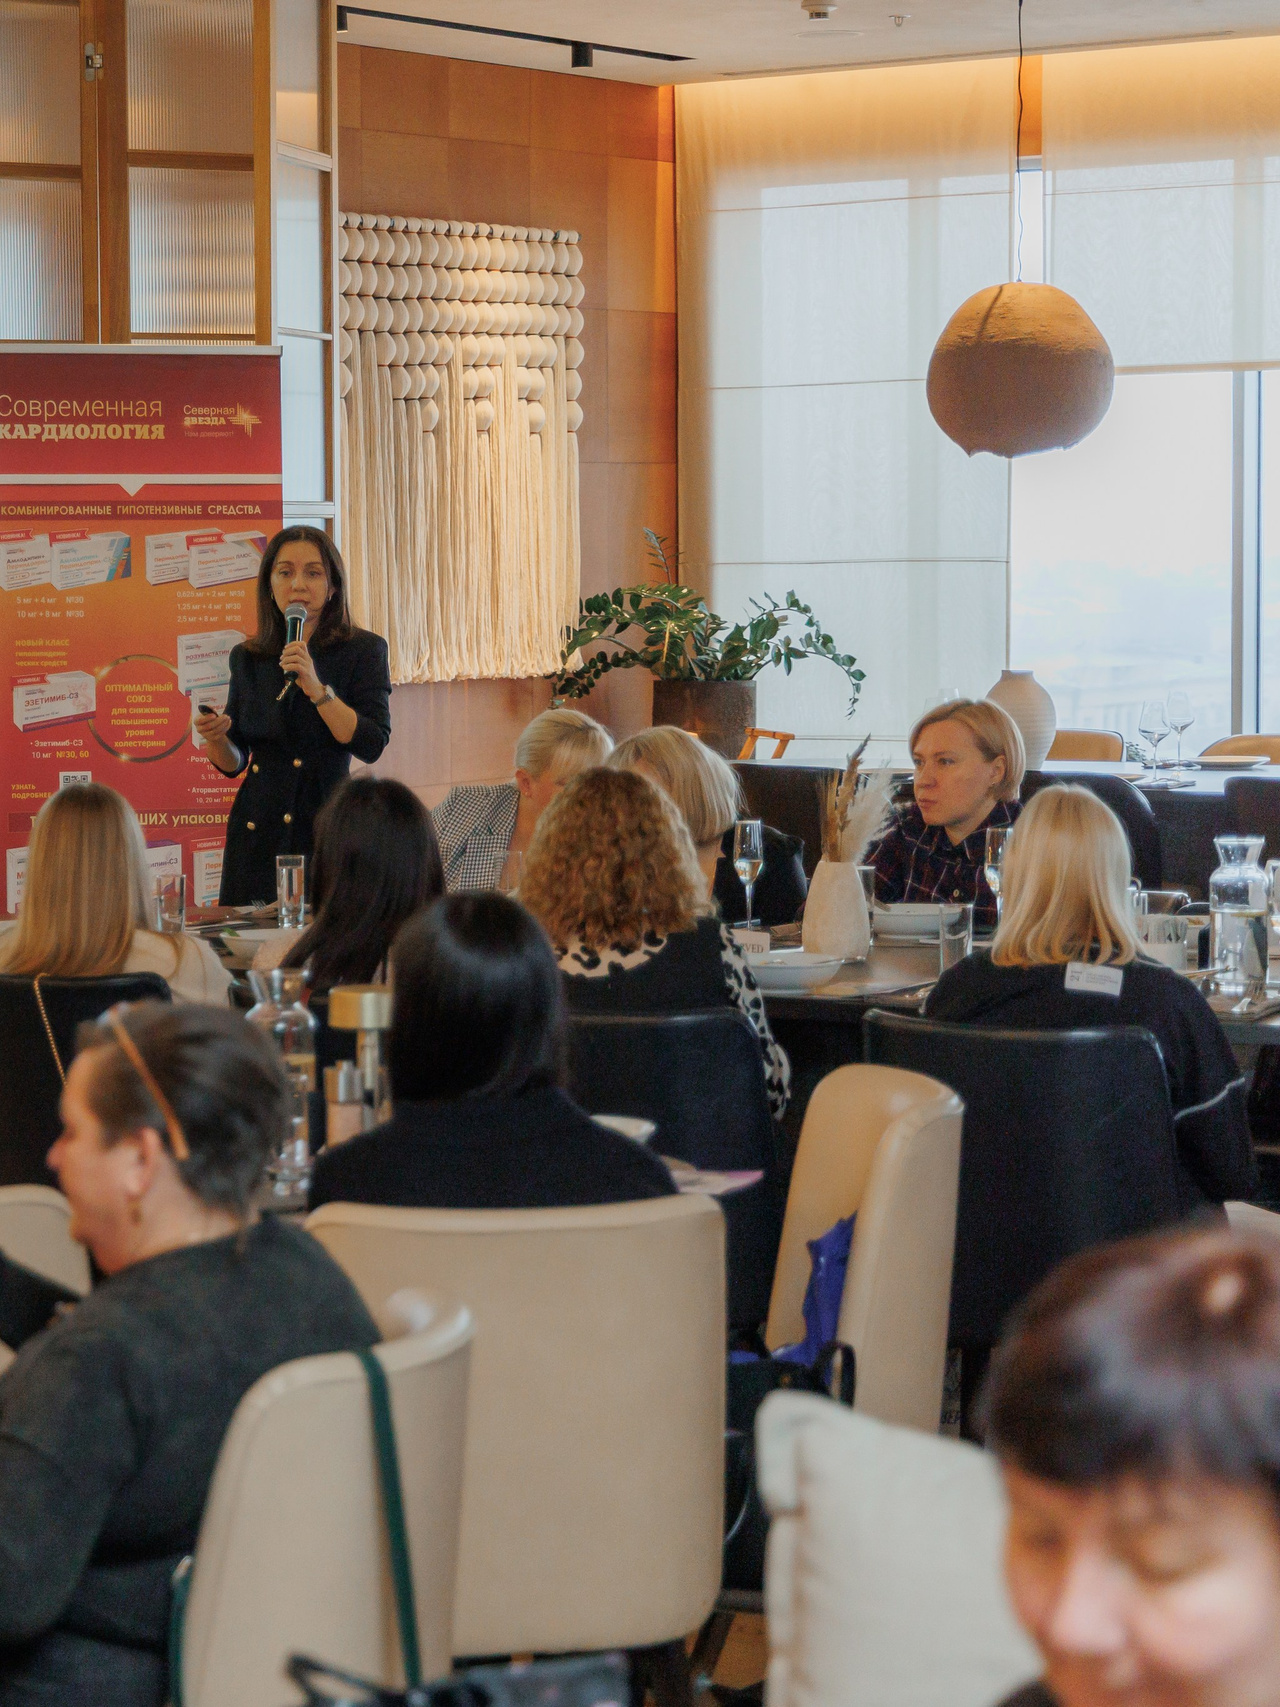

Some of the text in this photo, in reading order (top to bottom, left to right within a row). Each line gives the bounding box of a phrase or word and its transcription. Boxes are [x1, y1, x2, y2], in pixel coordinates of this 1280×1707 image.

[183, 404, 235, 417] Северная
[184, 416, 226, 426] ЗВЕЗДА
[1, 504, 262, 516] КОМБИНИРОВАННЫЕ ГИПОТЕНЗИВНЫЕ СРЕДСТВА
[16, 638, 43, 646] НОВЫЙ
[105, 682, 173, 692] ОПТИМАЛЬНЫЙ
[24, 692, 79, 707] ЭЗЕТИМИБ-СЗ
[126, 695, 152, 703] СОЮЗ
[111, 707, 127, 715] для
[125, 729, 155, 737] уровня
[34, 739, 83, 747] Эзетимиб-СЗ
[114, 740, 166, 748] холестерина
